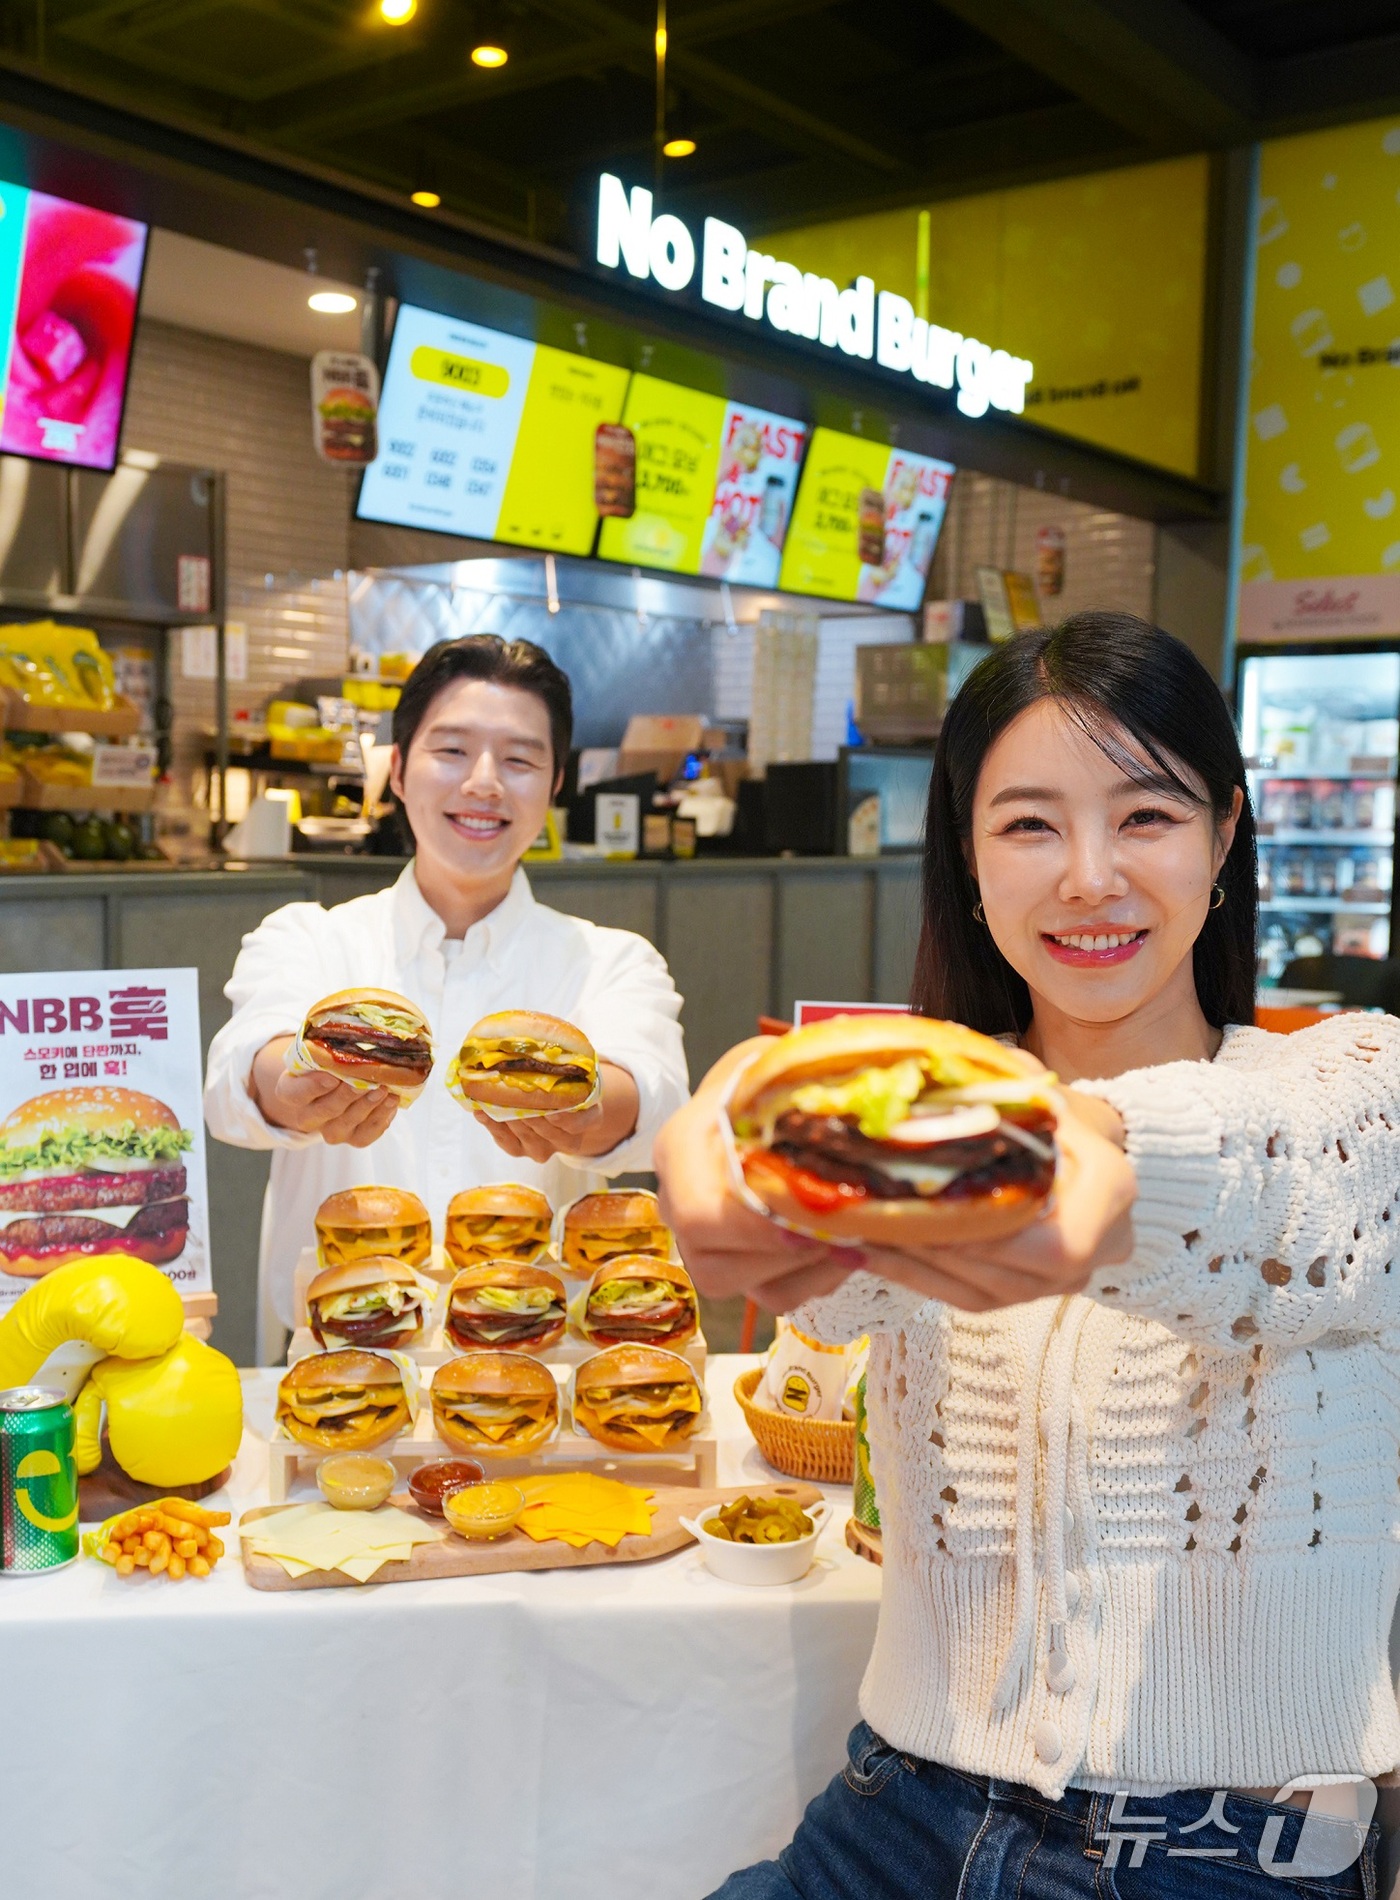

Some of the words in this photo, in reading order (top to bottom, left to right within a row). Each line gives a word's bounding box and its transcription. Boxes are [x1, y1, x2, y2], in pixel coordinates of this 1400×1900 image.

[597, 172, 695, 291] No
[702, 216, 875, 360] Brand
[877, 290, 1034, 418] Burger
[23, 1046, 78, 1061] 스모키에
[39, 1064, 57, 1080] 한
[63, 1062, 98, 1079] 입에
[103, 1060, 128, 1076] 훅!
